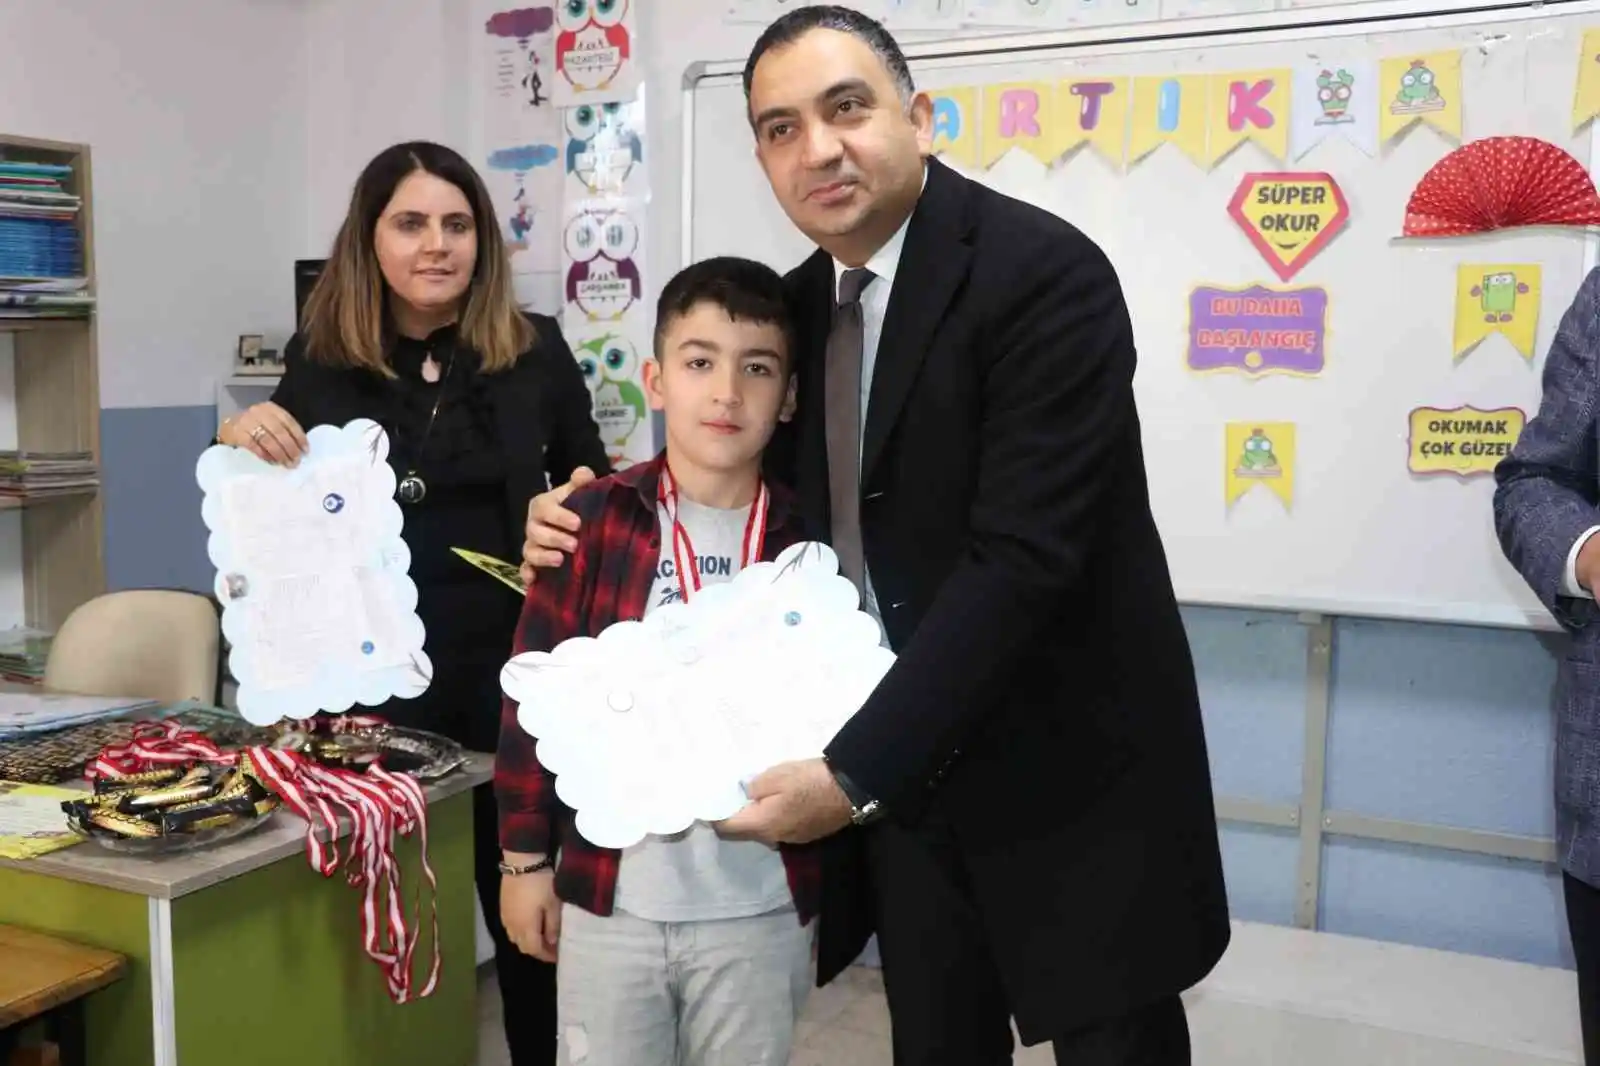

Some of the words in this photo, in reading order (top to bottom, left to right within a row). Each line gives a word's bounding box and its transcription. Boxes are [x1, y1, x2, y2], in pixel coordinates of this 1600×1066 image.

[1257, 183, 1327, 205] SÜPER
[1260, 214, 1320, 232] OKUR
[1211, 297, 1240, 316] BU
[1243, 297, 1303, 317] DAHA
[1197, 329, 1318, 354] BAŞLANGIÇ
[1428, 420, 1508, 434] OKUMAK
[1420, 441, 1455, 459] ÇOK
